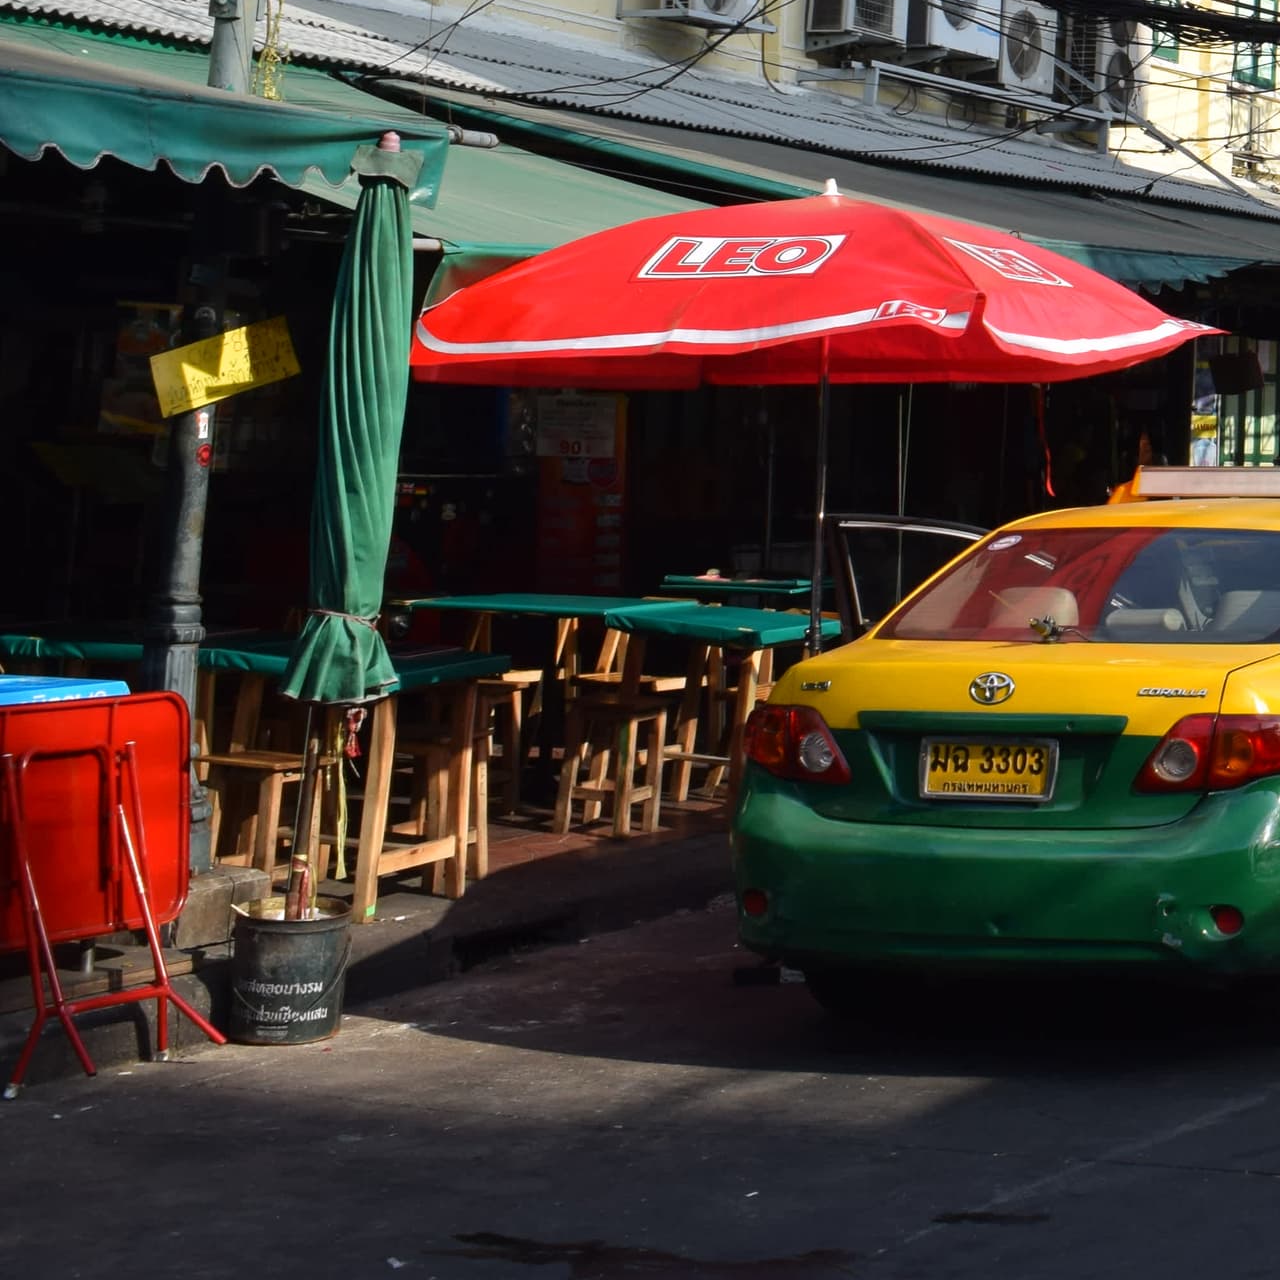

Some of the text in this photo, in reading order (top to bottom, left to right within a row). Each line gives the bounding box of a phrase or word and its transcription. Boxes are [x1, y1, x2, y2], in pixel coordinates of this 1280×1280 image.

[644, 237, 833, 277] LEO
[878, 301, 946, 323] LEO
[1137, 687, 1209, 698] COROLLA
[930, 745, 1045, 775] มฉ 3303
[942, 780, 1029, 794] กรุงเทพมหานคร
